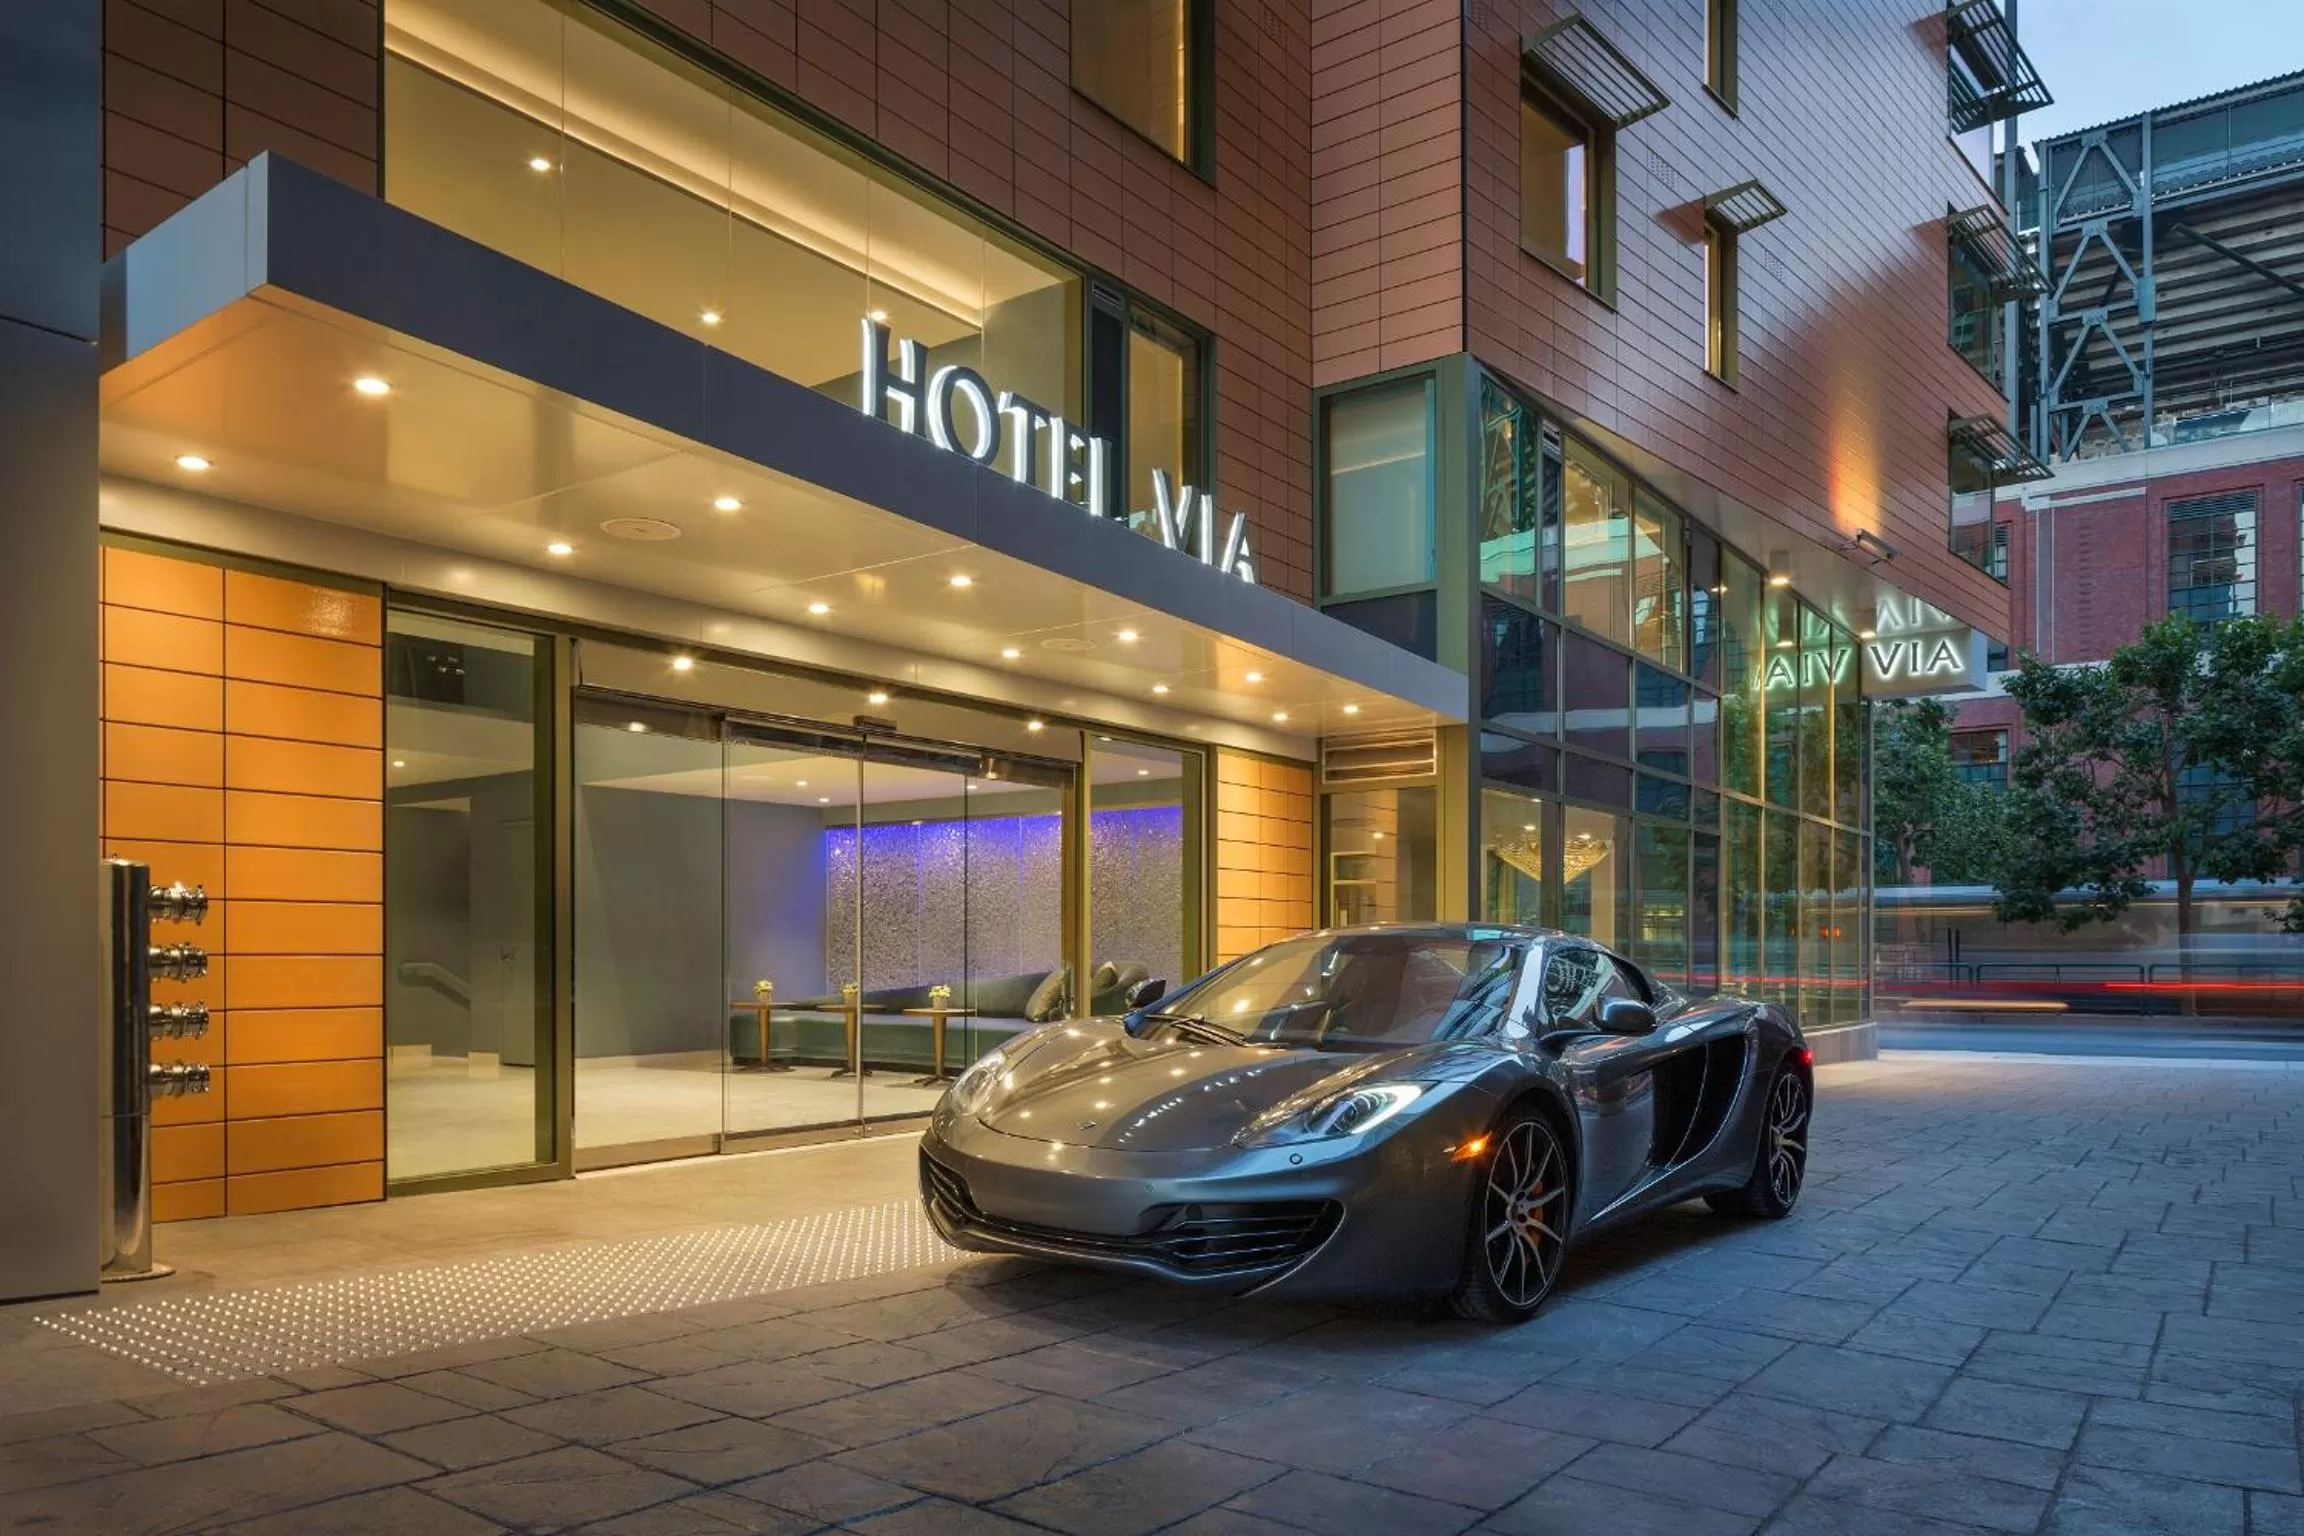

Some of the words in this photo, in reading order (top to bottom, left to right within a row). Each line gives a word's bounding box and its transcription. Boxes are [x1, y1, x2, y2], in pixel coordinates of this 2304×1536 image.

[860, 318, 1122, 521] HOTEL
[1151, 467, 1261, 584] VIA
[1868, 638, 1964, 678] VIA
